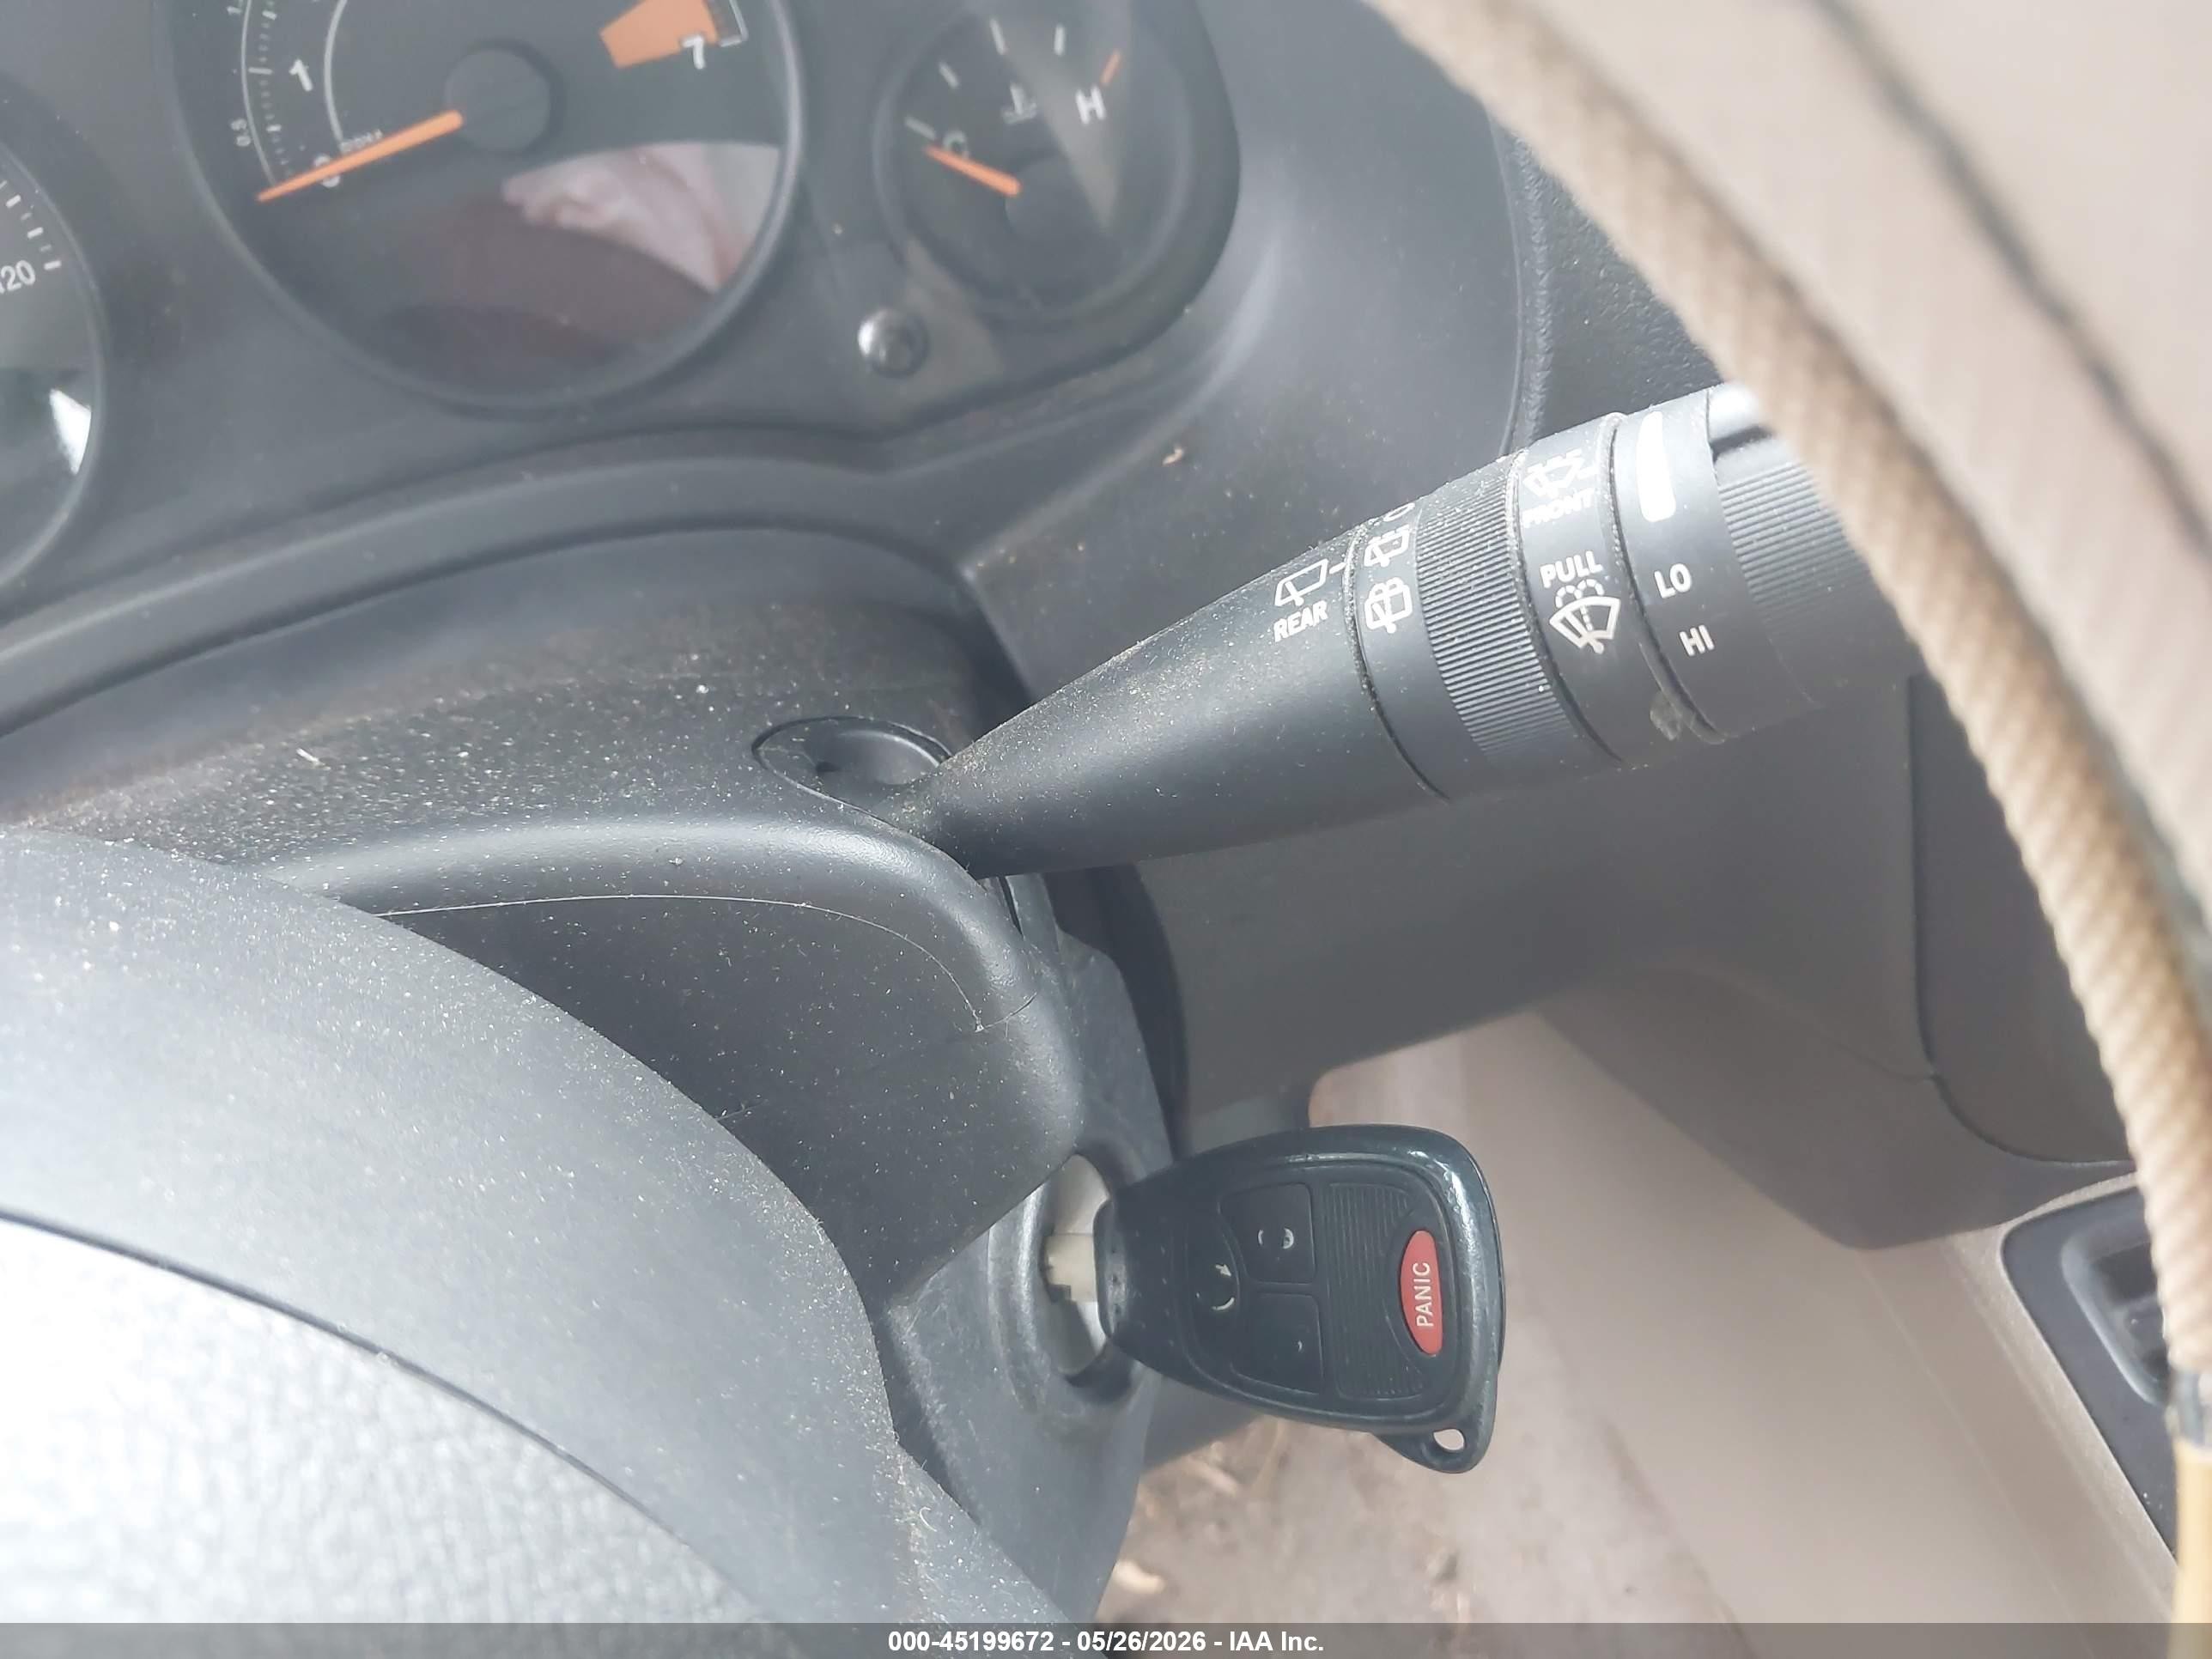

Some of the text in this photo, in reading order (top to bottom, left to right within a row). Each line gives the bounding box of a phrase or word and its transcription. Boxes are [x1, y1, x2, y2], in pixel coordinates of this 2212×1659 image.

[289, 58, 313, 92] 1
[1075, 84, 1106, 125] H
[0, 259, 35, 294] 20
[1540, 550, 1603, 589] PULL
[1654, 562, 1692, 599] LO
[1274, 600, 1328, 642] REAR
[1679, 624, 1715, 657] HI
[1413, 1262, 1434, 1327] PANIC
